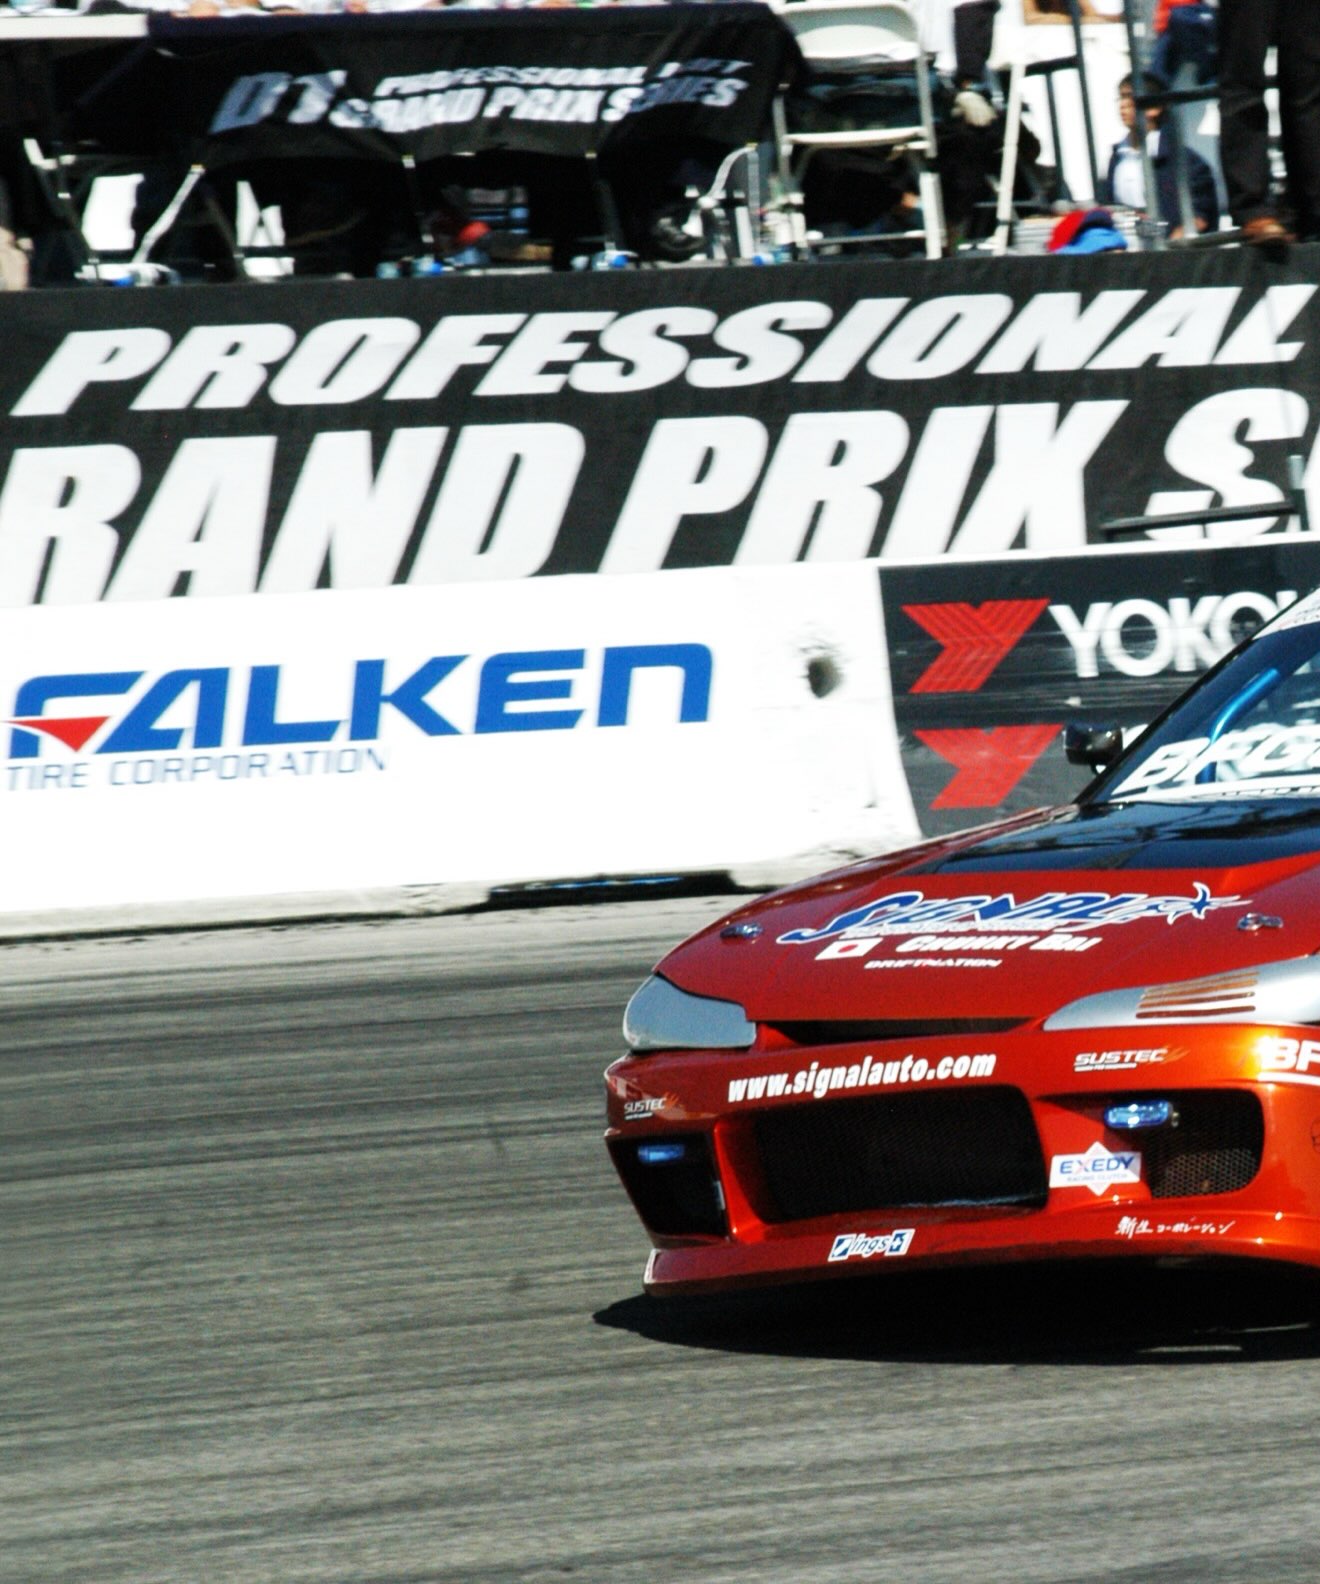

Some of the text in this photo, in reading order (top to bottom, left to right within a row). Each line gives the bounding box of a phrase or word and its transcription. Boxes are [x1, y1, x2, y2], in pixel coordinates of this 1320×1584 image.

[9, 281, 1320, 417] PROFESSIONAL
[597, 399, 1129, 575] PRIX
[3, 642, 713, 759] FALKEN
[6, 747, 387, 791] TIRE CORPORATION
[863, 958, 1003, 970] DRIFTNATION
[728, 1053, 997, 1103] www.signalauto.com
[1073, 1048, 1169, 1067] SUSTEC
[624, 1097, 667, 1114] SUSTEC
[1059, 1156, 1135, 1175] EXEDY
